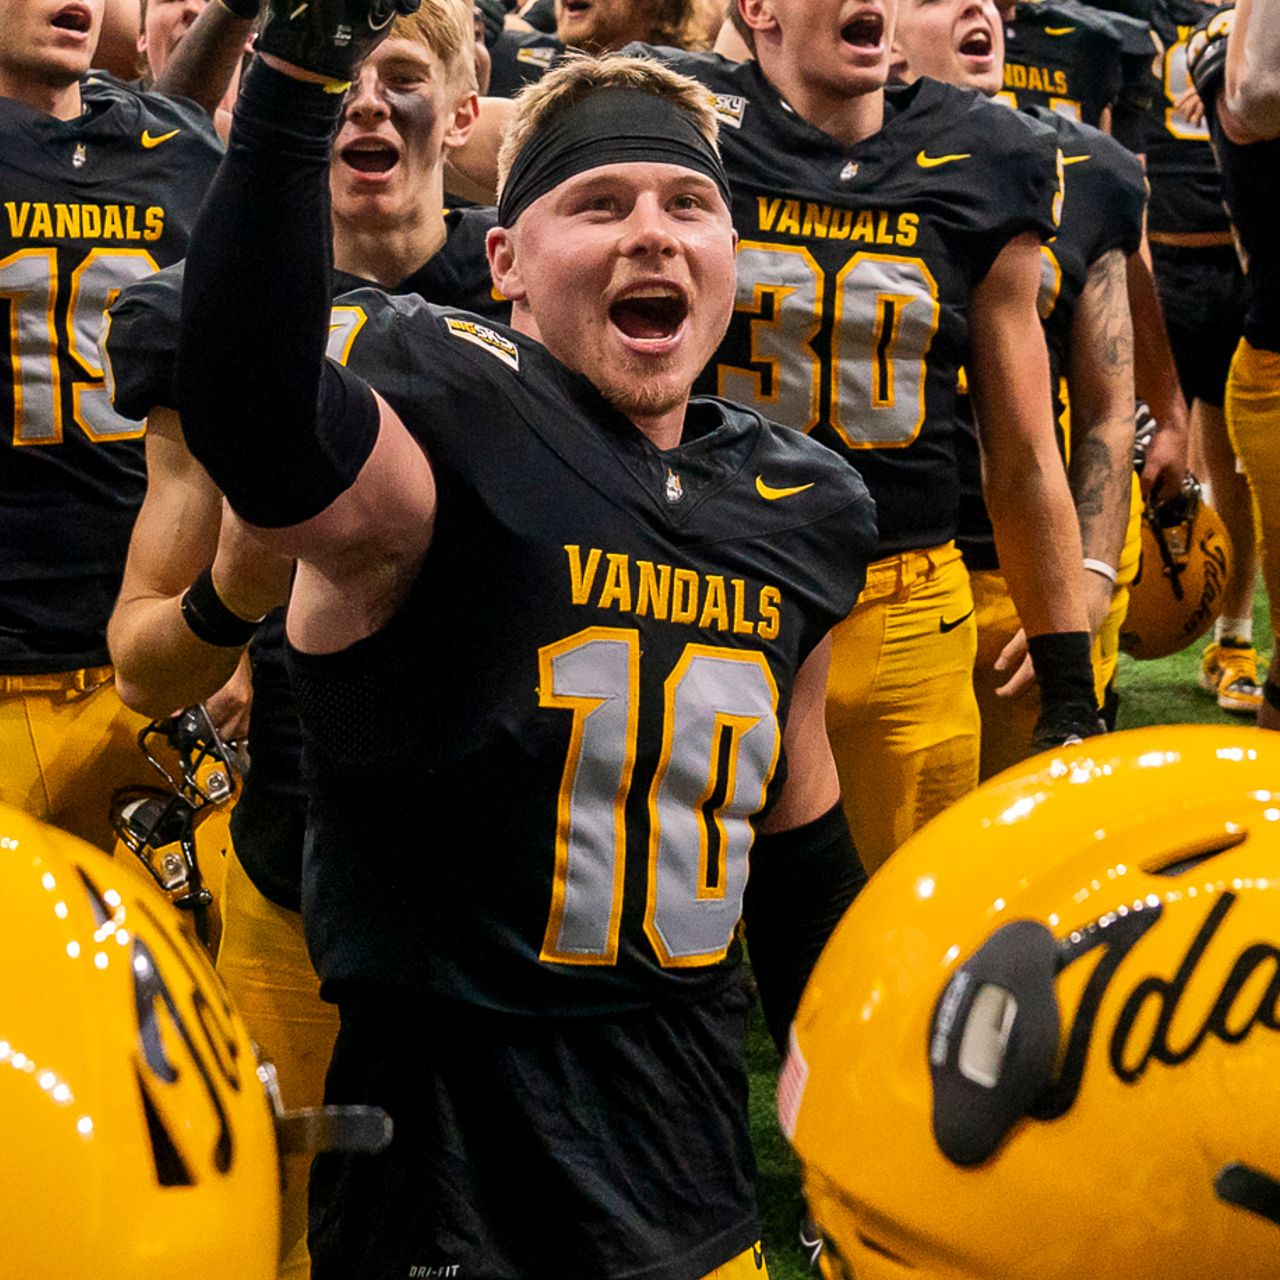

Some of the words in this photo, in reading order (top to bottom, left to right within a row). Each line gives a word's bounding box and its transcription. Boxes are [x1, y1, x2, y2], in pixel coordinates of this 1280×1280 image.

[1004, 63, 1068, 95] NDALS
[4, 201, 165, 241] VANDALS
[756, 196, 920, 247] VANDALS
[717, 239, 941, 450] 30
[563, 543, 783, 641] VANDALS
[536, 626, 783, 968] 10
[409, 1264, 460, 1278] DRI-FIT
